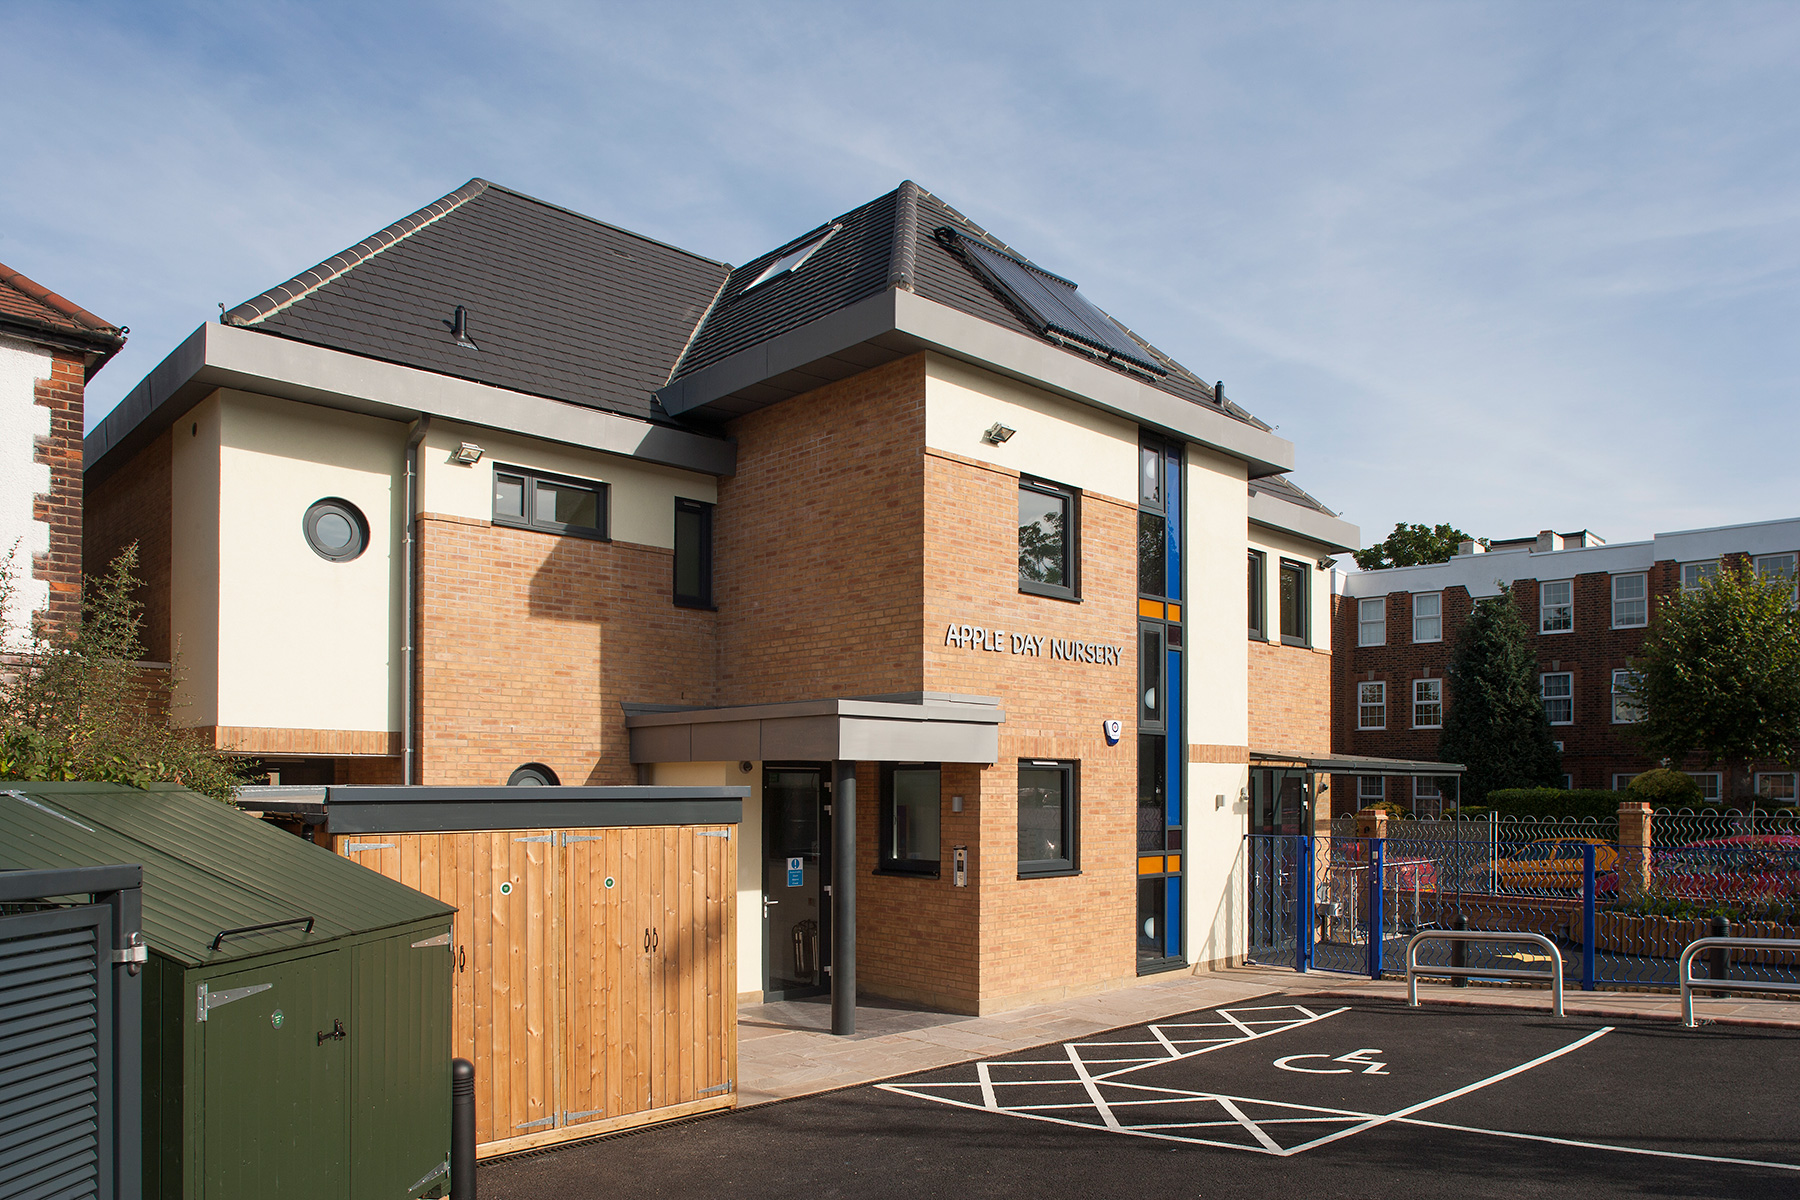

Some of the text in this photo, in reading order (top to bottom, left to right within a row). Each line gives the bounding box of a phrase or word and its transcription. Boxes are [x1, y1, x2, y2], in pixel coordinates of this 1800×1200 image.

[945, 623, 1124, 666] APPLE DAY NURSERY
